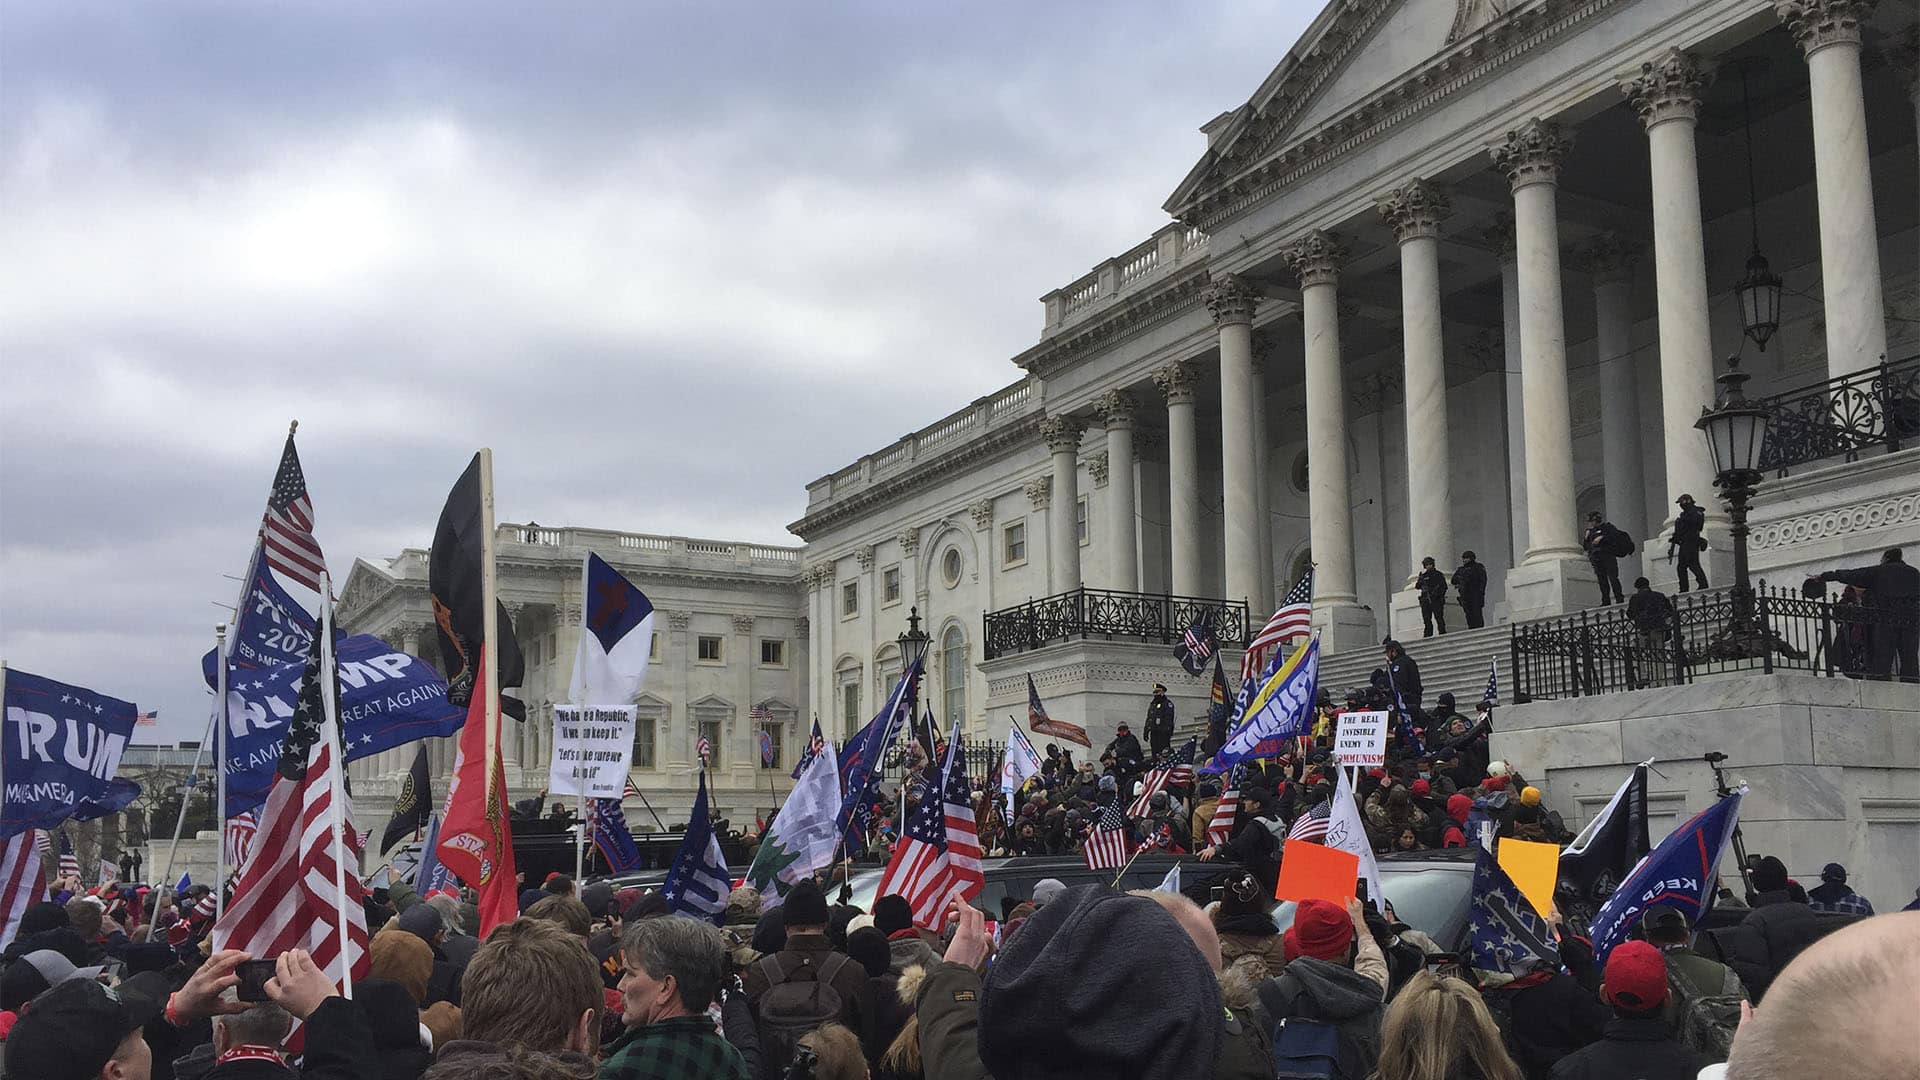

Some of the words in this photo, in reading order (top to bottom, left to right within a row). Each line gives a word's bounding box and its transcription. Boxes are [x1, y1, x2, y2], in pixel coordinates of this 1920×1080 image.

[226, 652, 413, 738] RUMP
[340, 700, 383, 723] REAT
[386, 683, 447, 712] AGAIN!
[570, 710, 588, 721] hae
[1343, 716, 1358, 725] THE
[1361, 715, 1379, 724] REAL
[592, 726, 610, 740] keep
[1342, 728, 1377, 737] INVISIBLE
[6, 706, 127, 781] TRUM
[1339, 740, 1361, 748] ENEMY
[1367, 739, 1375, 748] IS
[1337, 753, 1384, 765] OMMUNISM
